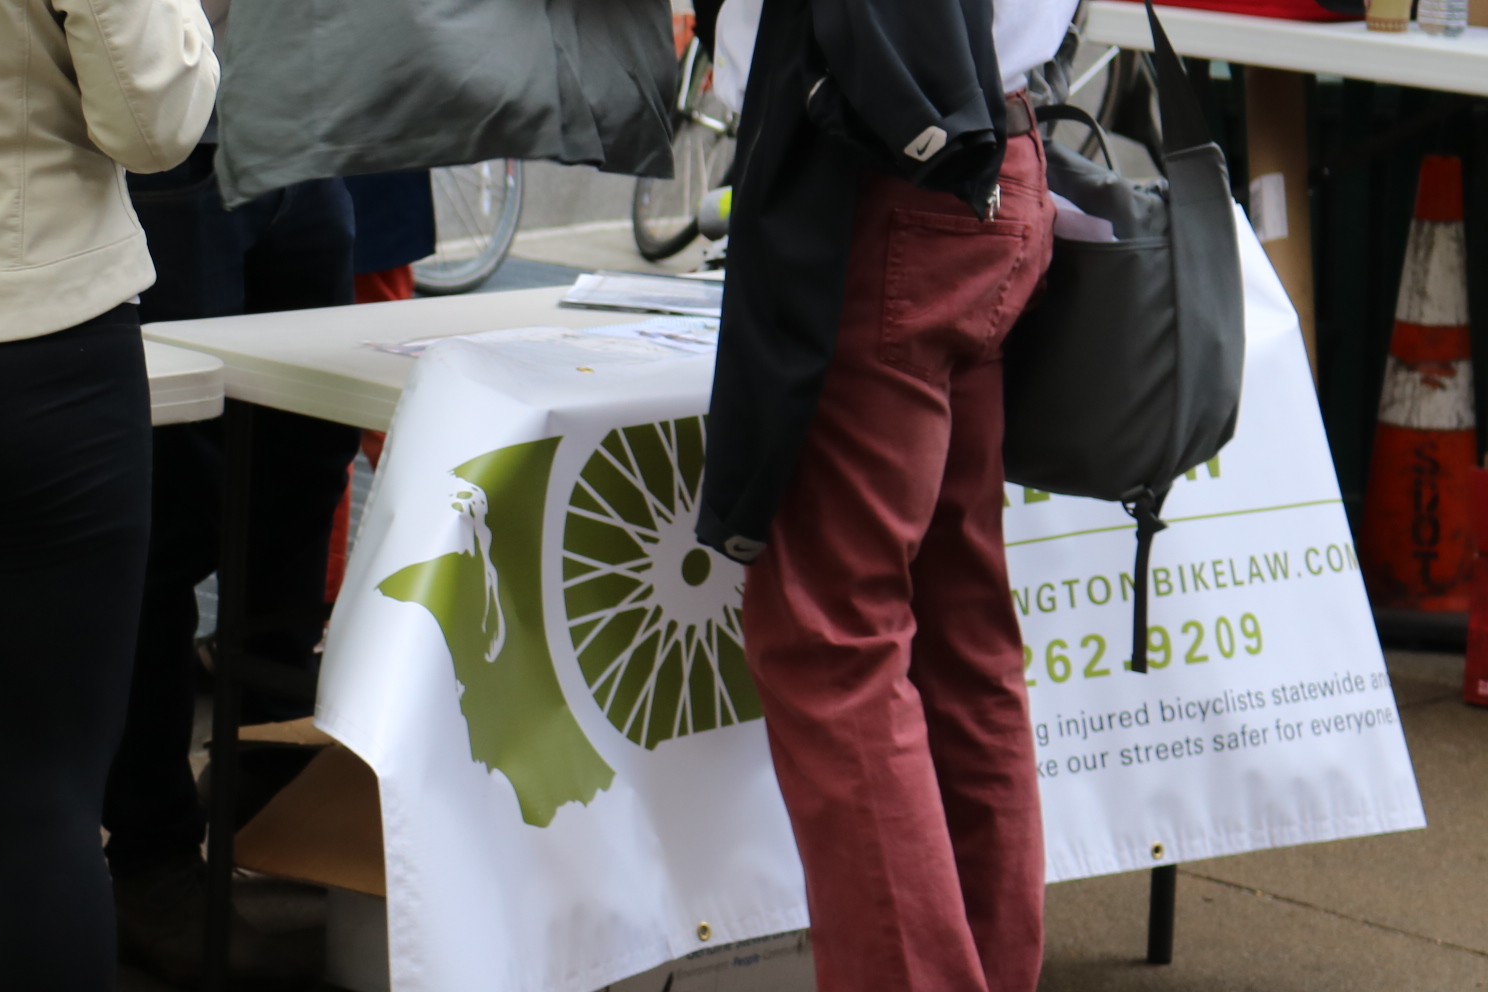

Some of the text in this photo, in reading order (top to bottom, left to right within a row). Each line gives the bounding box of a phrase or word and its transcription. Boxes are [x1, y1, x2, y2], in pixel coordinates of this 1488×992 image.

[1057, 702, 1150, 740] injured
[1159, 688, 1266, 723] bicyclists
[1271, 670, 1366, 706] statewide
[1067, 750, 1109, 774] our
[1120, 735, 1204, 767] streets
[1212, 724, 1269, 753] safer
[1275, 718, 1303, 742] for
